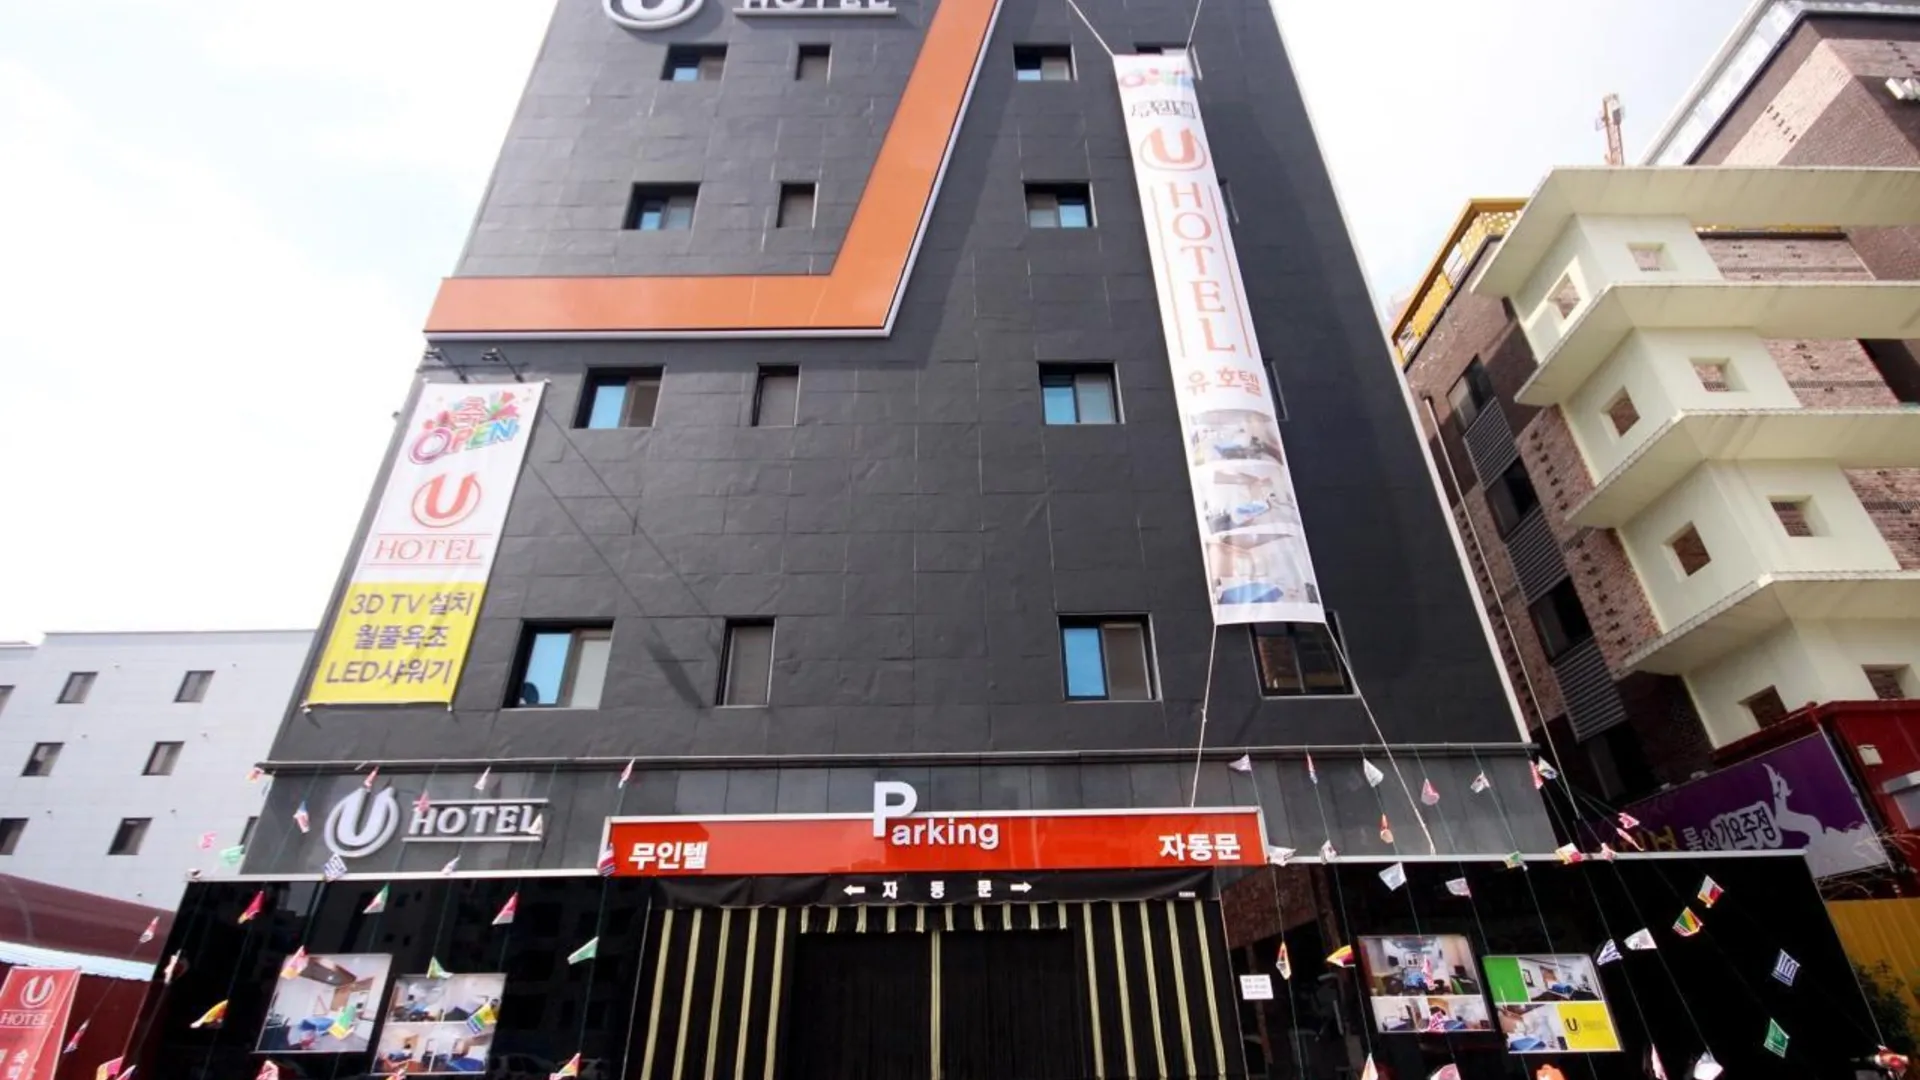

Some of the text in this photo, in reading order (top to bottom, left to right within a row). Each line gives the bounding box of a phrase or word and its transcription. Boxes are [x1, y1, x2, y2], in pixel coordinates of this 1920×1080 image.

[1150, 128, 1195, 163] U
[1167, 182, 1236, 352] HOTEL
[1185, 367, 1263, 397] 유 호텔
[408, 418, 519, 465] OPEN
[424, 471, 477, 519] U
[373, 539, 482, 561] HOTEL
[349, 591, 475, 616] 3D TV 설치
[408, 804, 541, 835] HOTEL
[873, 781, 999, 850] Parking
[628, 841, 709, 871] 무인텔
[1158, 832, 1241, 862] 자동문
[0, 1013, 48, 1026] HOTEL
